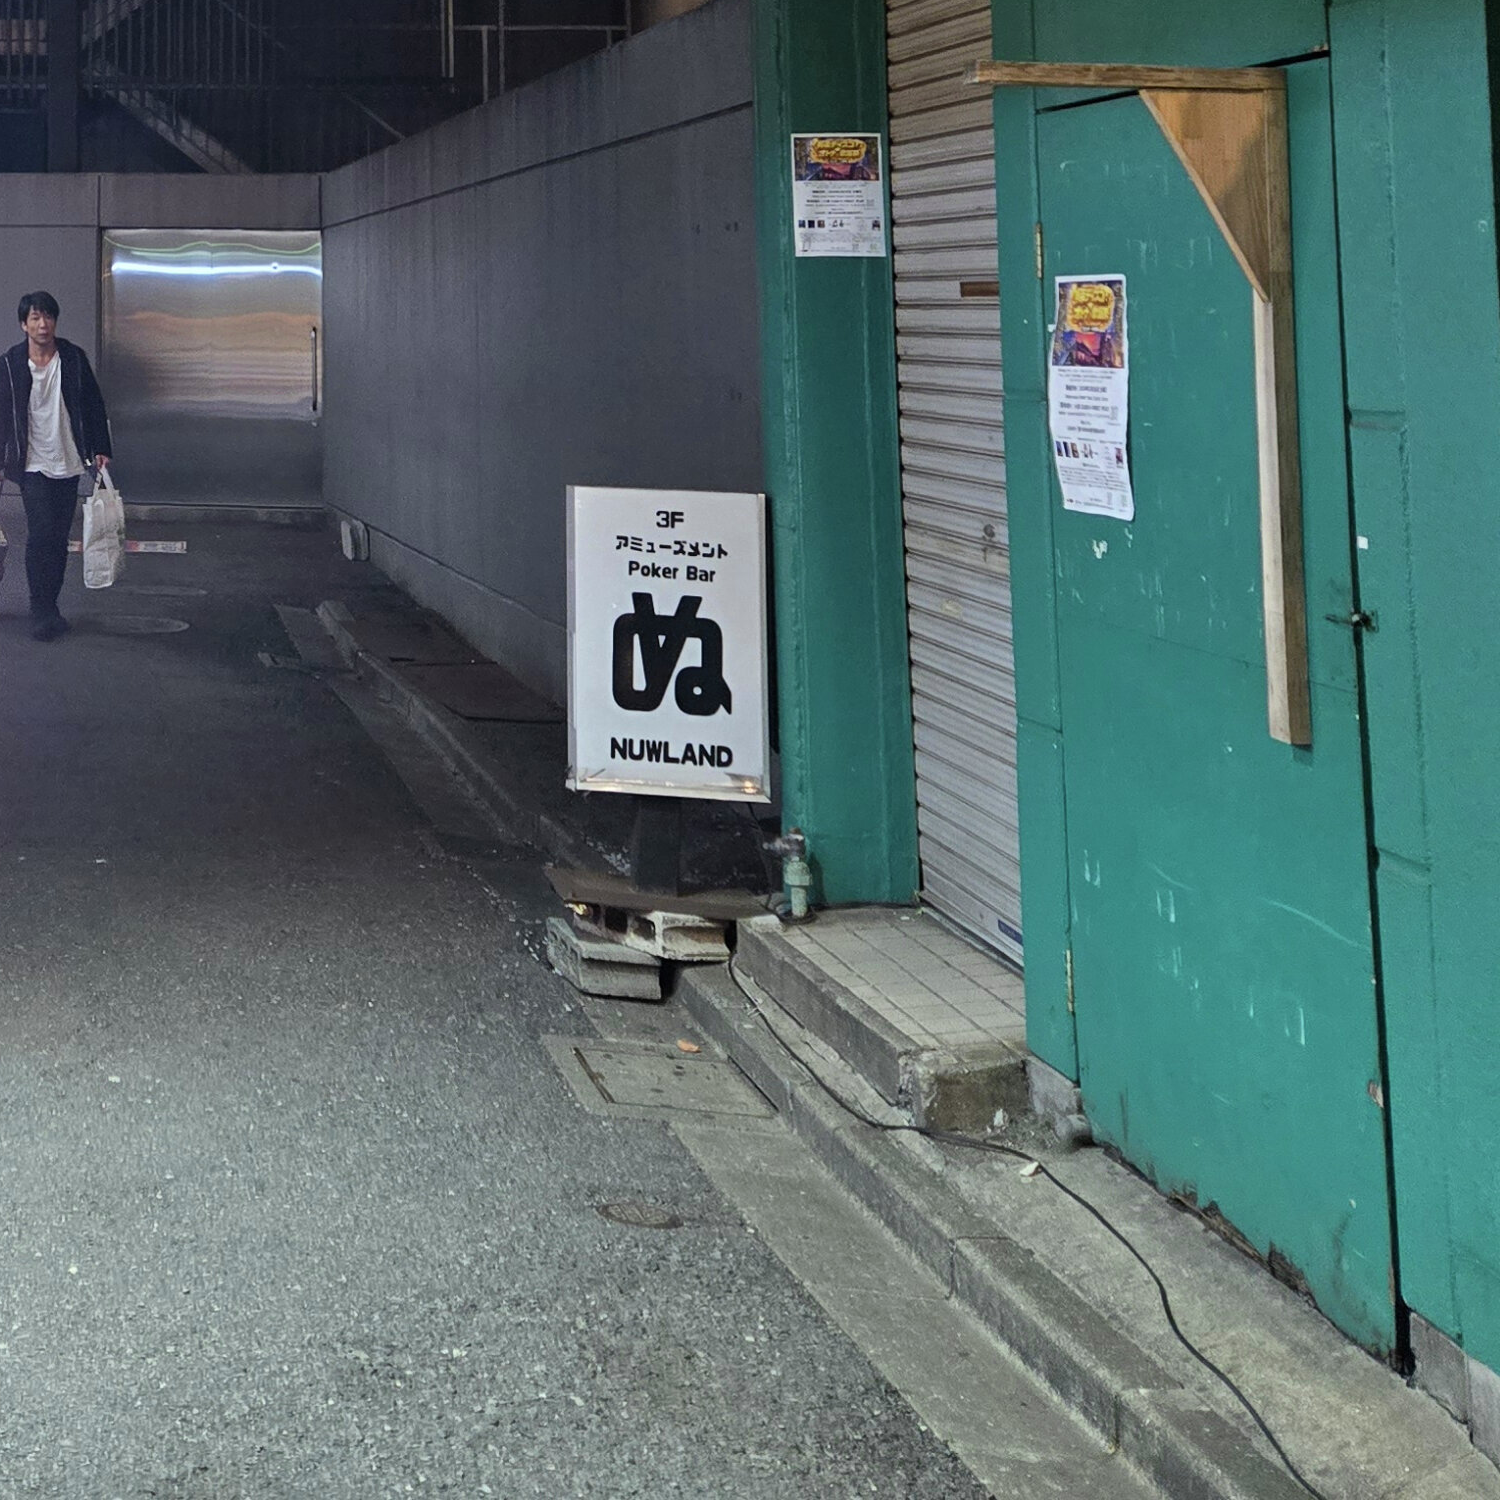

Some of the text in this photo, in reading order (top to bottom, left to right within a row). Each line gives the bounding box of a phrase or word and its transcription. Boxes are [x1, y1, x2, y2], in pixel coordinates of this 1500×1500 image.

[656, 510, 685, 529] 3F
[615, 534, 728, 559] アミューズメント
[628, 560, 716, 582] Poker Bar
[610, 737, 734, 768] NUWLAND
